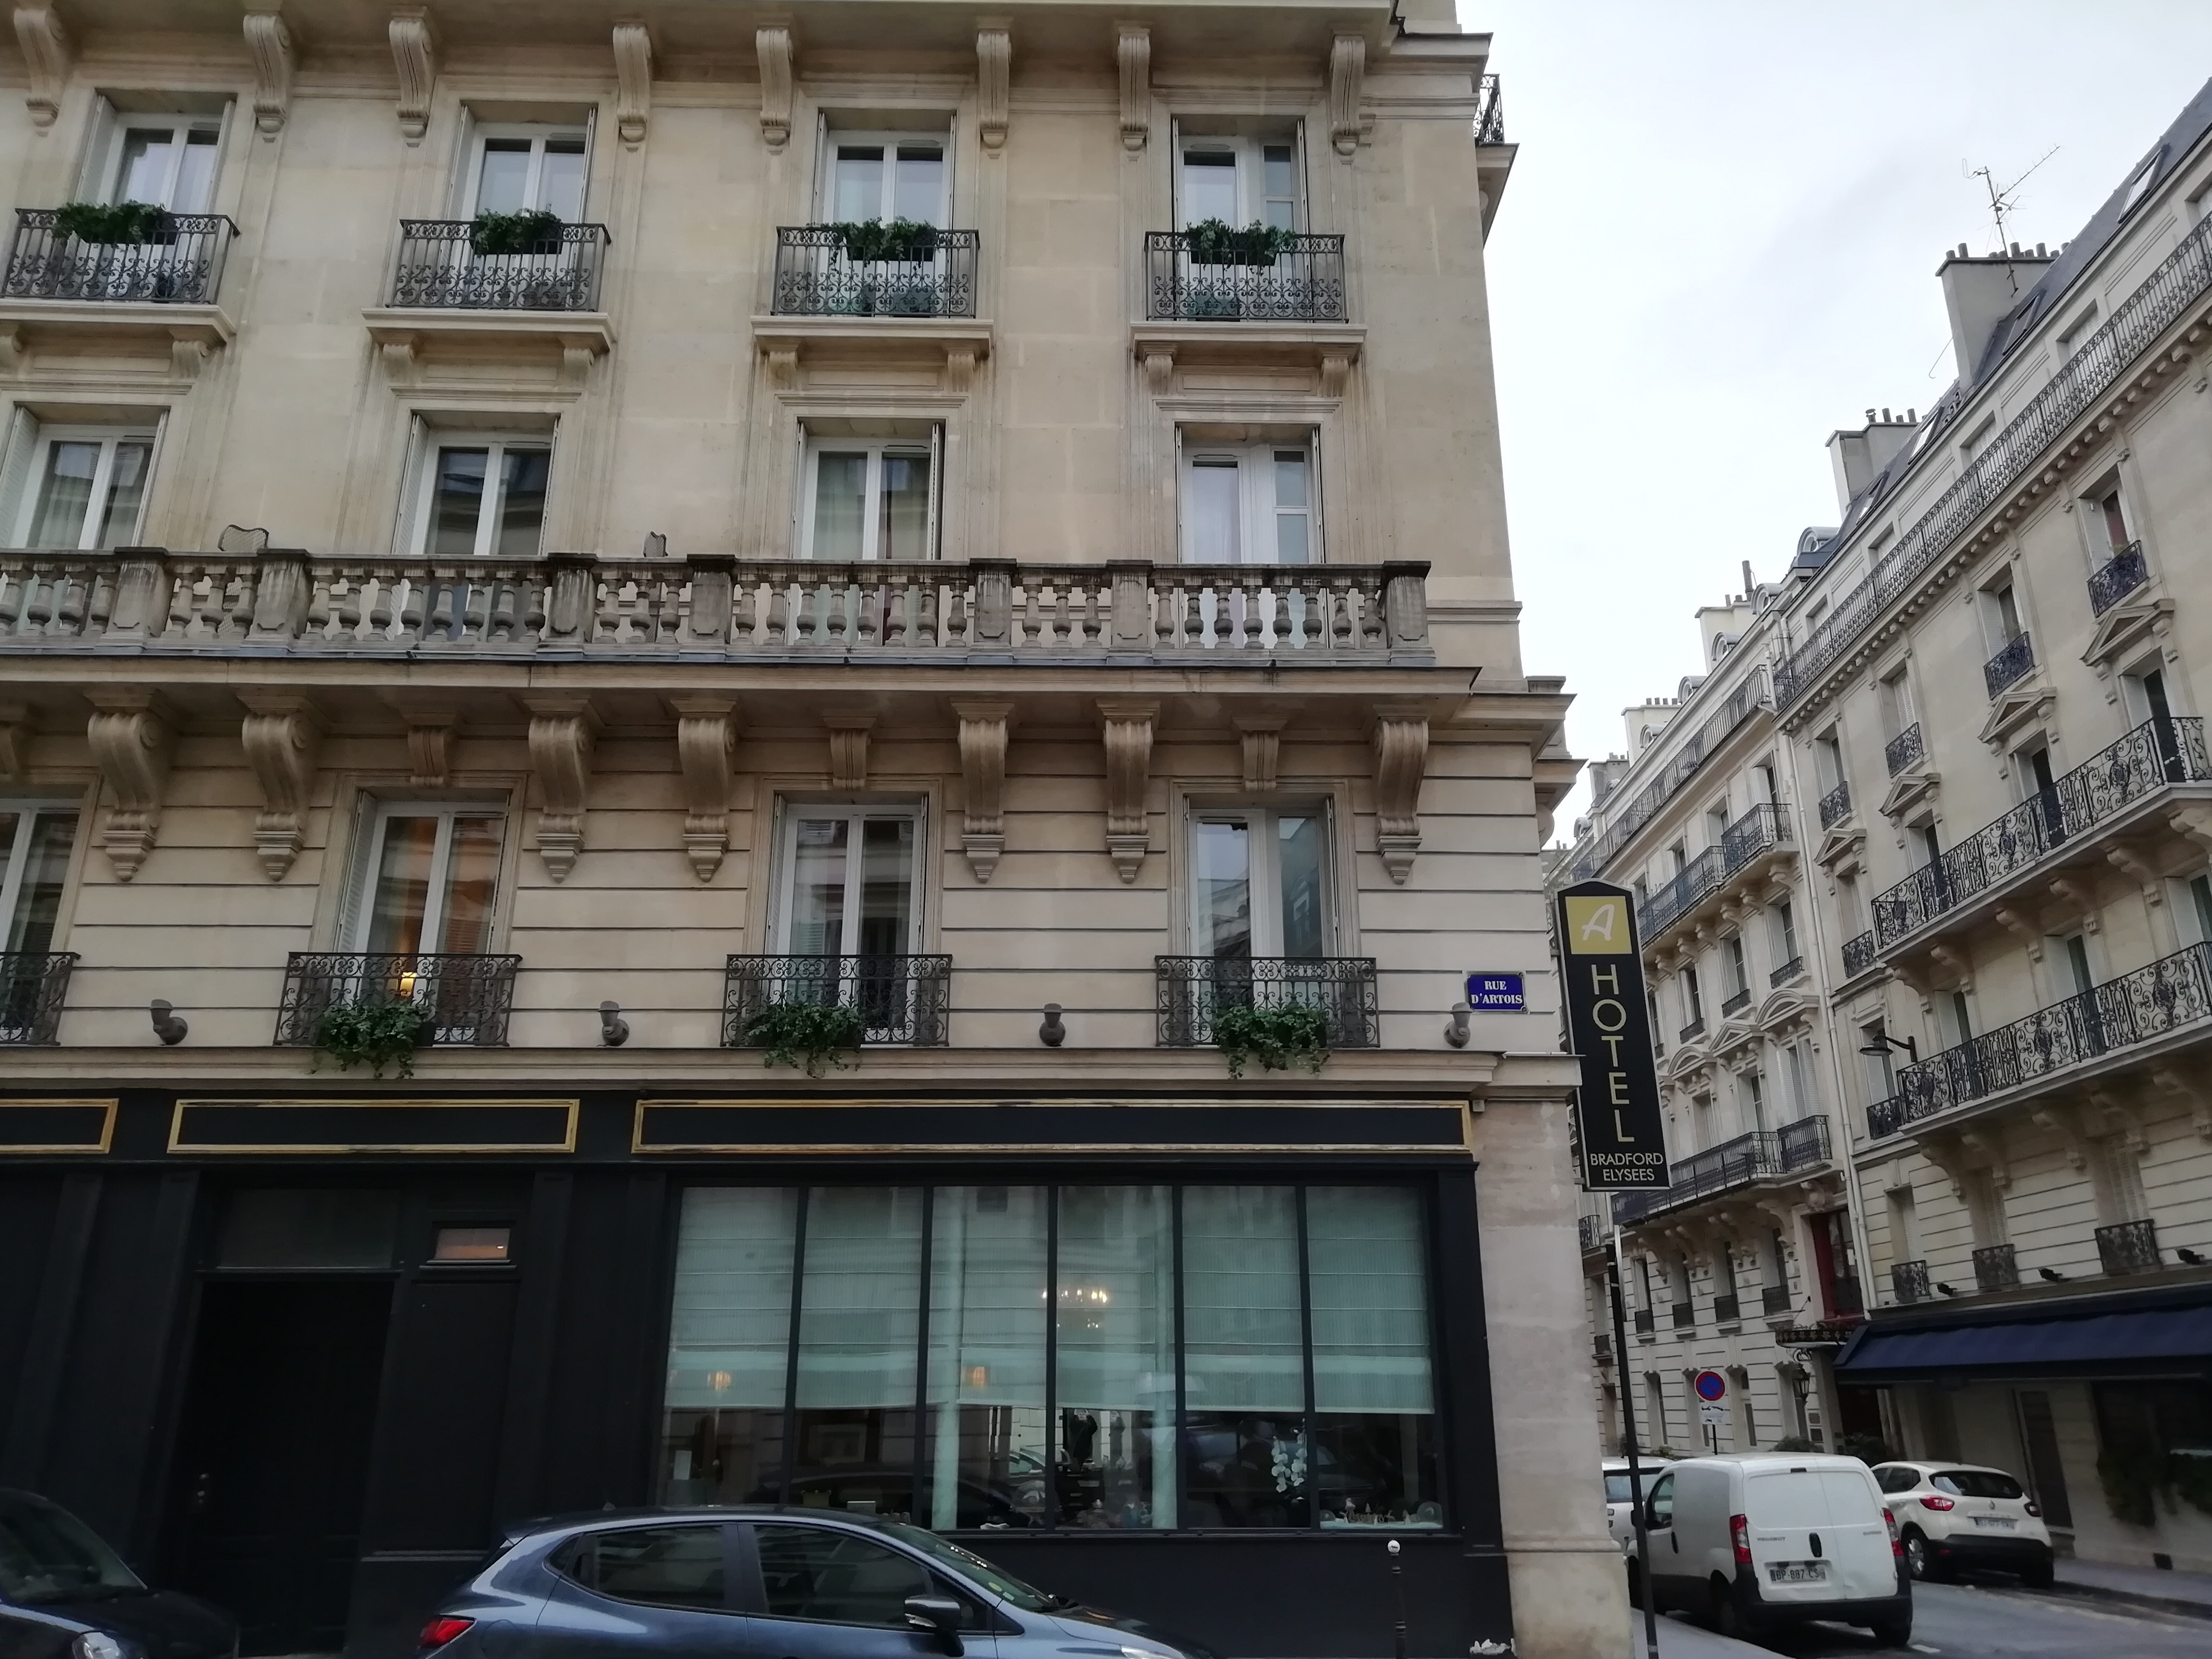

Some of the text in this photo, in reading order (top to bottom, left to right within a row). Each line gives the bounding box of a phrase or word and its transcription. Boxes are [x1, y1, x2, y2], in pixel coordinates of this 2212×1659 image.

[1582, 904, 1615, 941] A
[1485, 981, 1506, 990] RUE
[1471, 993, 1522, 1003] D'ARTOIS
[1591, 964, 1635, 1142] HOTEL
[1590, 1153, 1663, 1165] BRADFORD
[1603, 1168, 1655, 1180] ELYSEES
